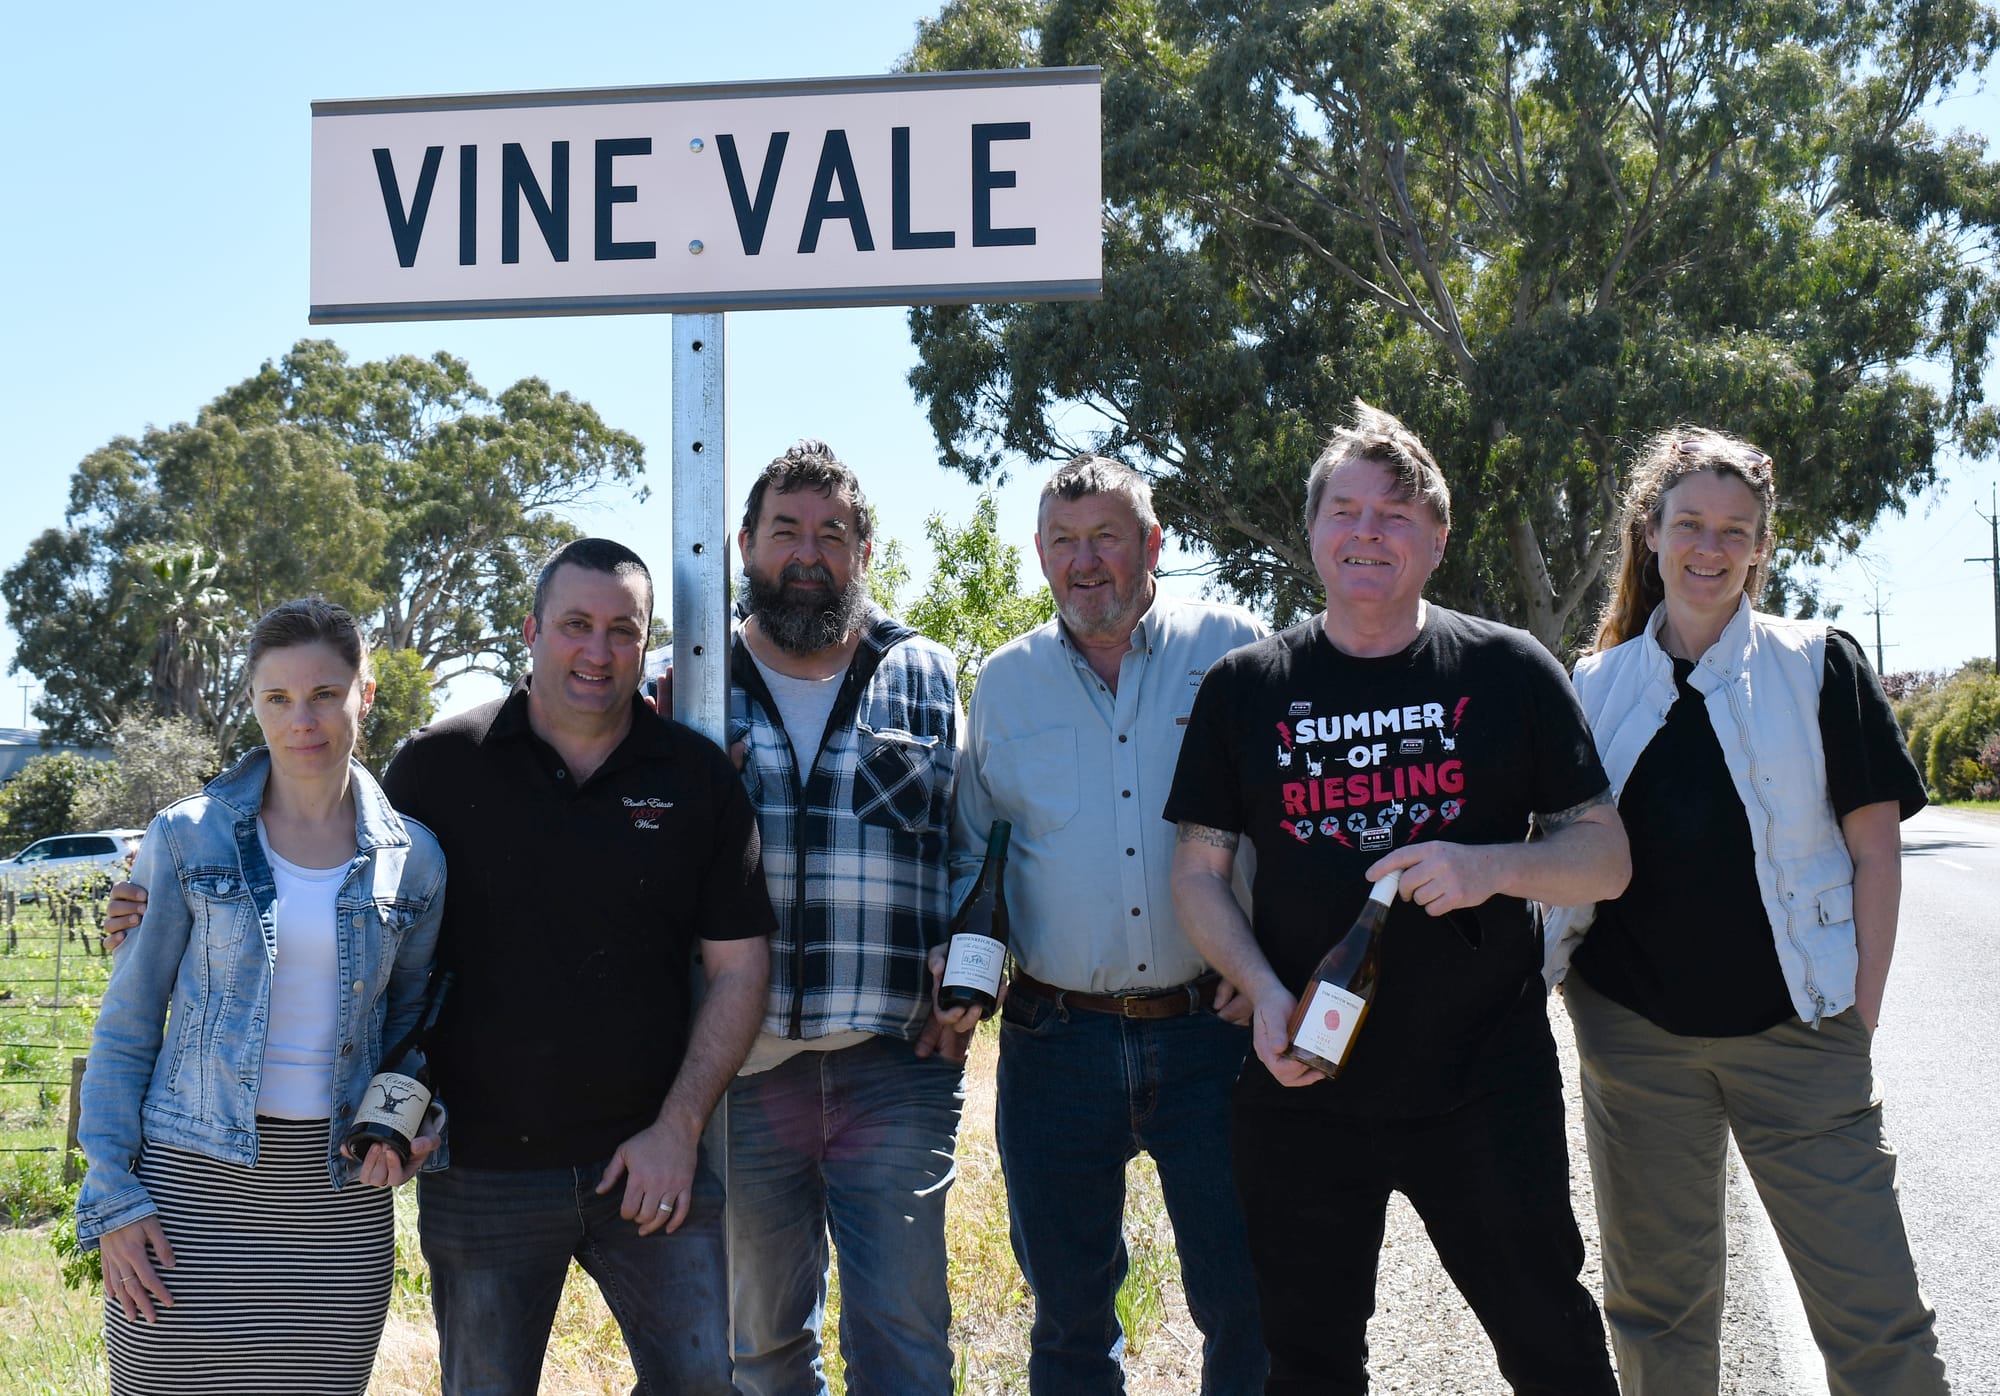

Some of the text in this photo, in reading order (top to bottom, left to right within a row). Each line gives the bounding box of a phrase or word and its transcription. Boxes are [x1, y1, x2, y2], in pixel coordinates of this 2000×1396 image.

[373, 121, 1037, 268] VINE VALE
[1296, 702, 1446, 744] SUMMER
[1347, 743, 1388, 768] OF
[1282, 760, 1465, 816] RIESLING
